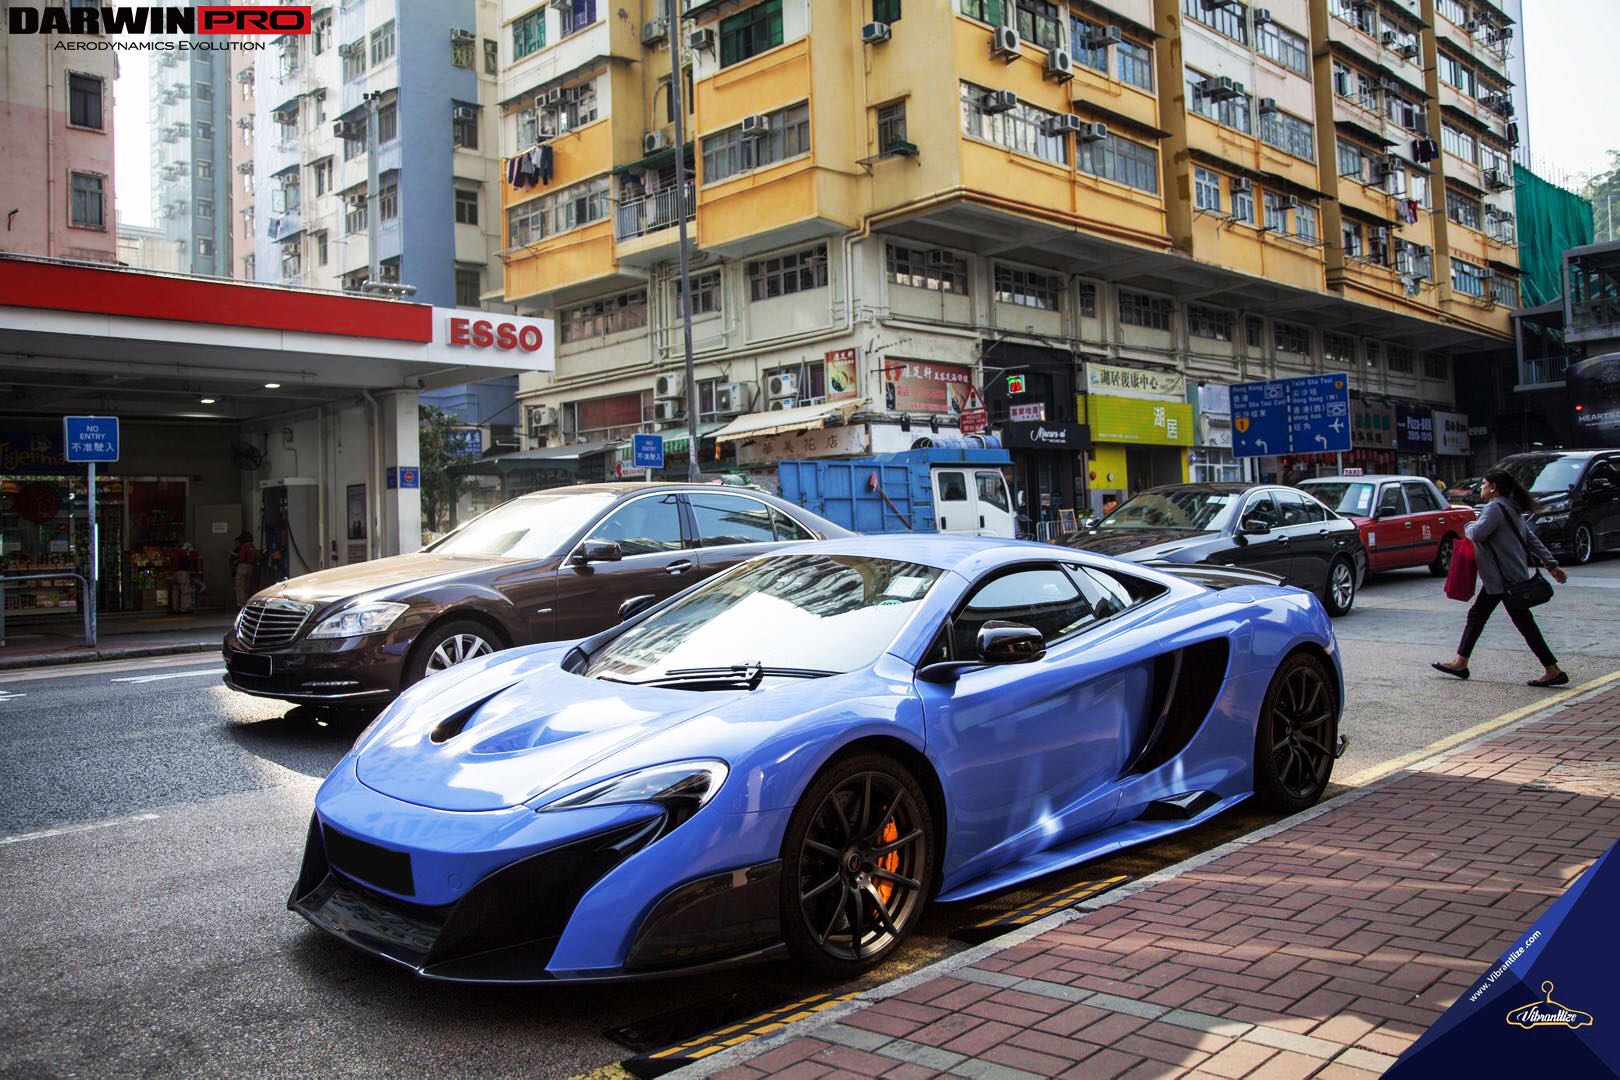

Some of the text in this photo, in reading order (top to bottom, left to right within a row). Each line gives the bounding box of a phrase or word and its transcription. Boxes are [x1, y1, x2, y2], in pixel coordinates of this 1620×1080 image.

[450, 317, 543, 352] ESSO
[71, 442, 115, 452] 不准駛入
